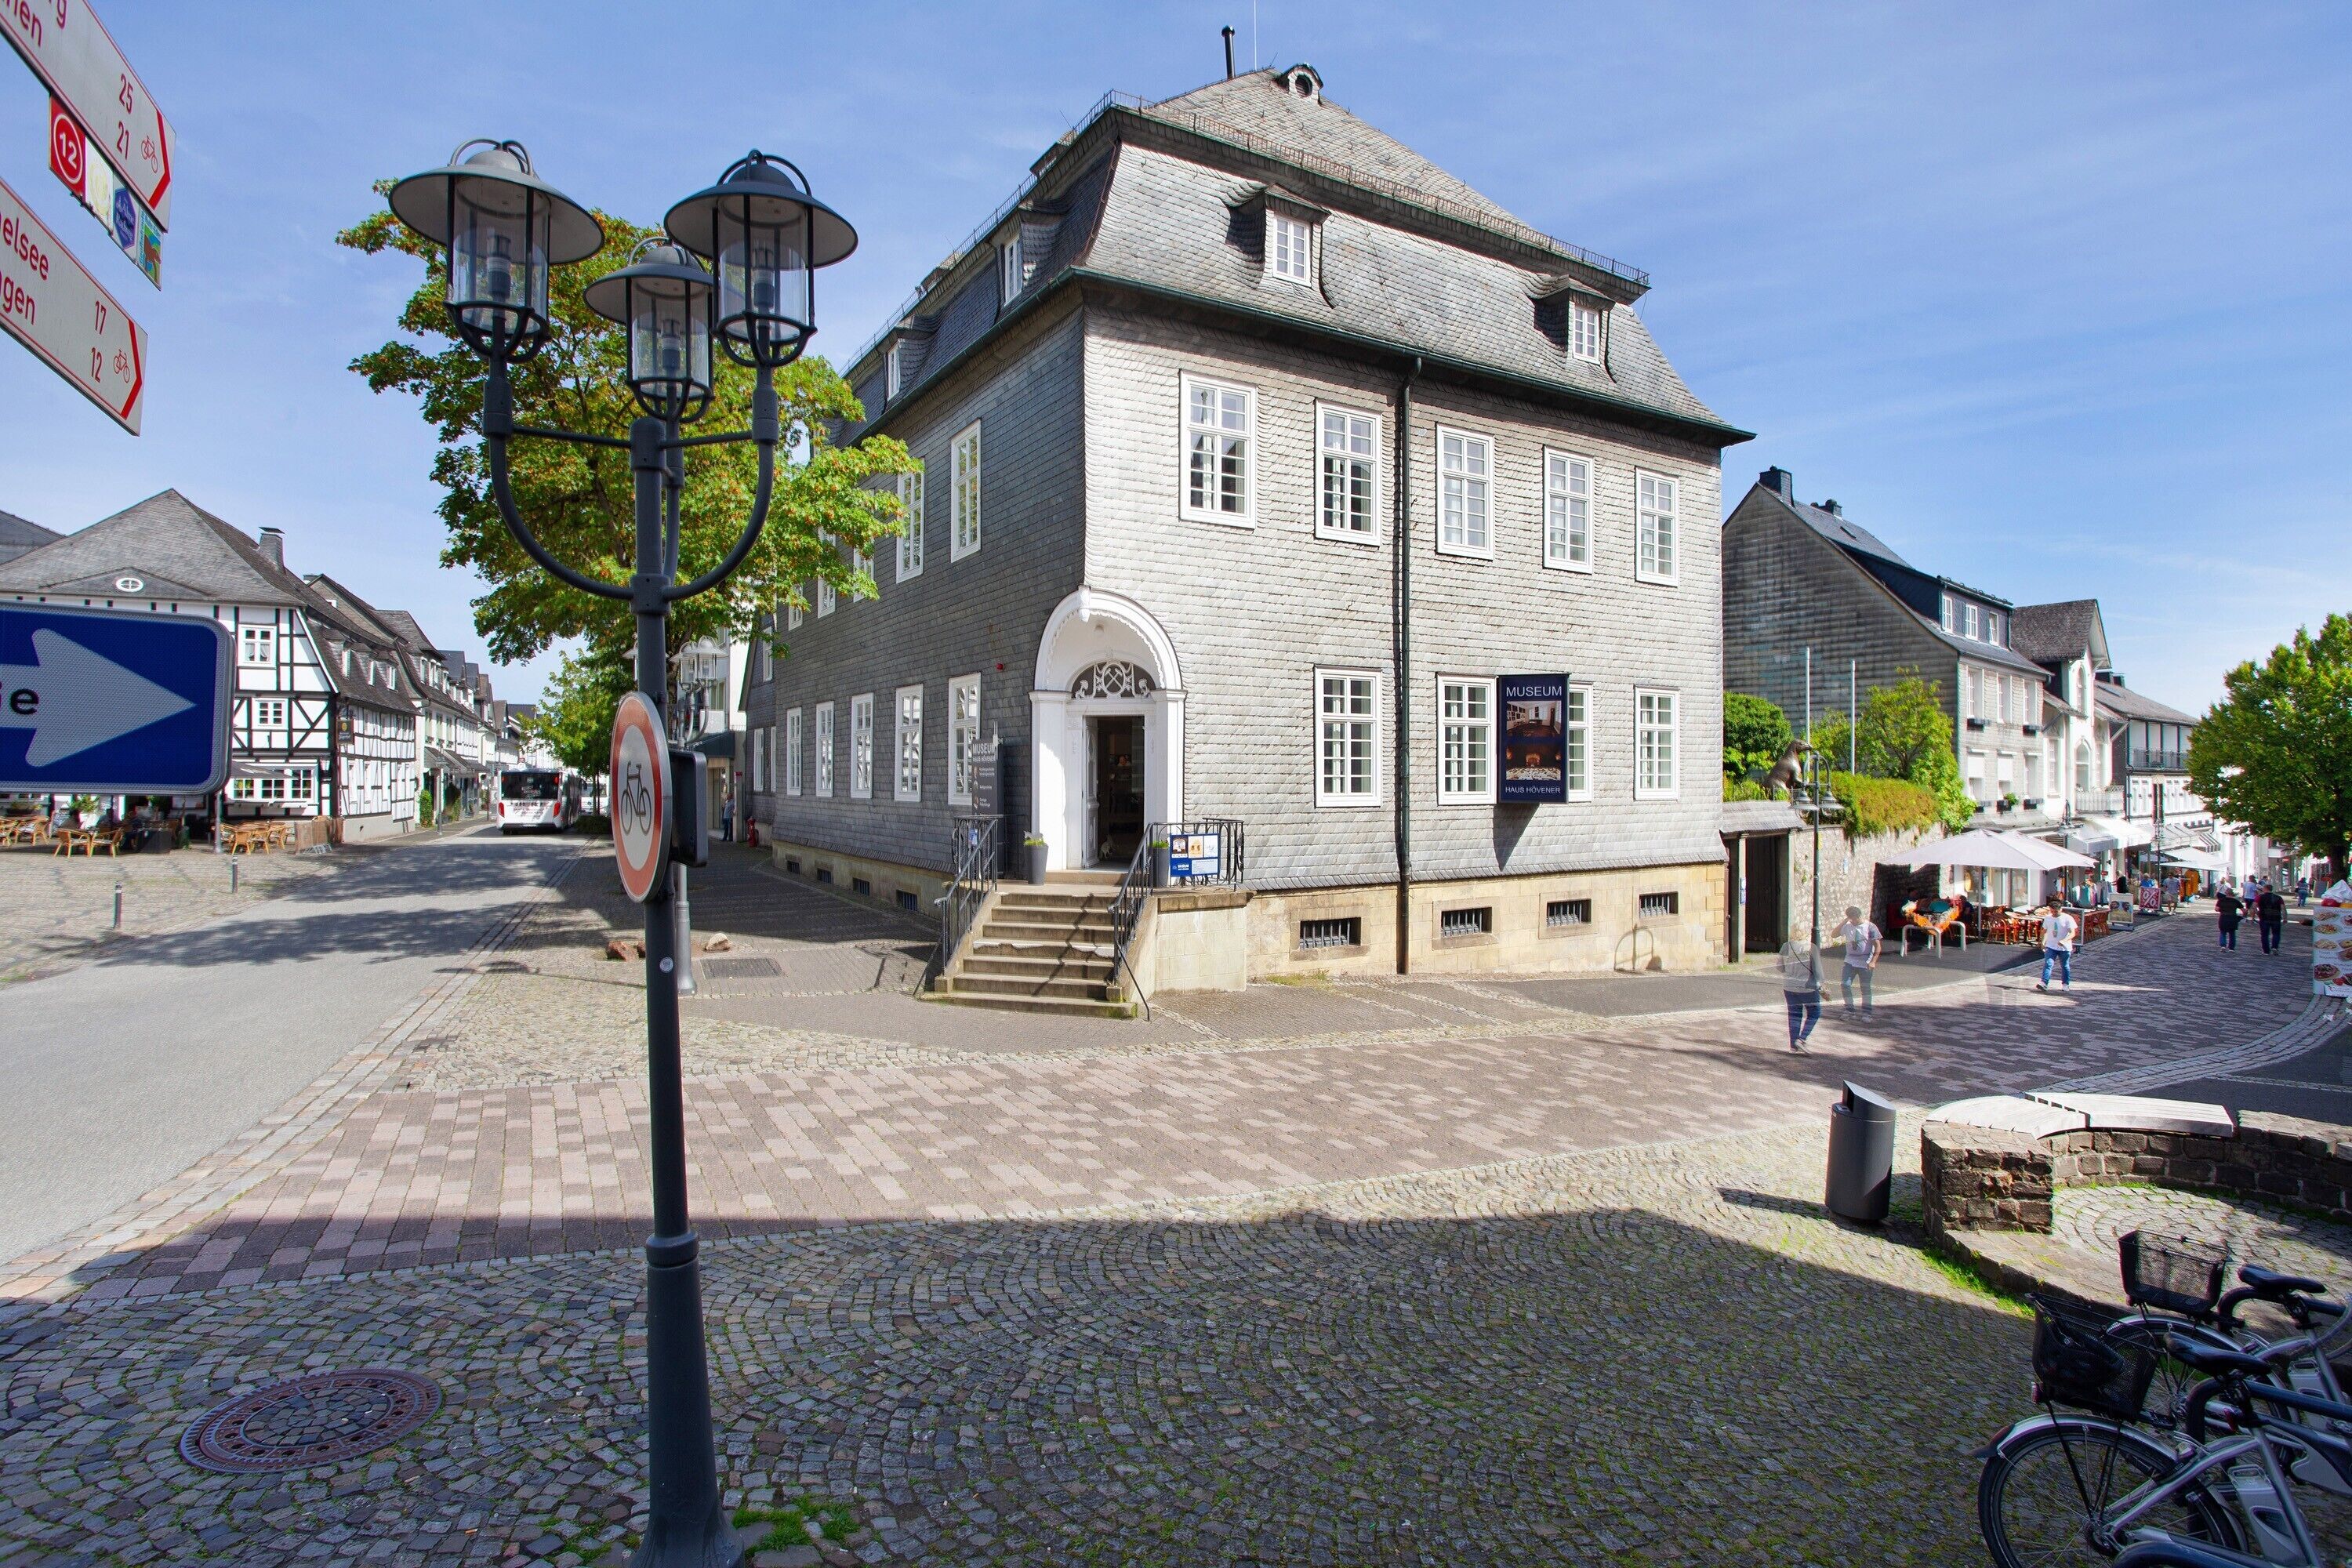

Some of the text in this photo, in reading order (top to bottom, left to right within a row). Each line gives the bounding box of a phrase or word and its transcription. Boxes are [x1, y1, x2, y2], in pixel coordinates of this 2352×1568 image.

[119, 73, 133, 114] 25
[60, 132, 77, 169] 12
[117, 121, 129, 160] 21
[0, 212, 107, 335] elsee 17
[0, 269, 103, 383] gen 12
[1506, 686, 1562, 697] MUSEUM
[973, 742, 996, 754] MUSEUM
[1526, 785, 1561, 793] HÖVENER
